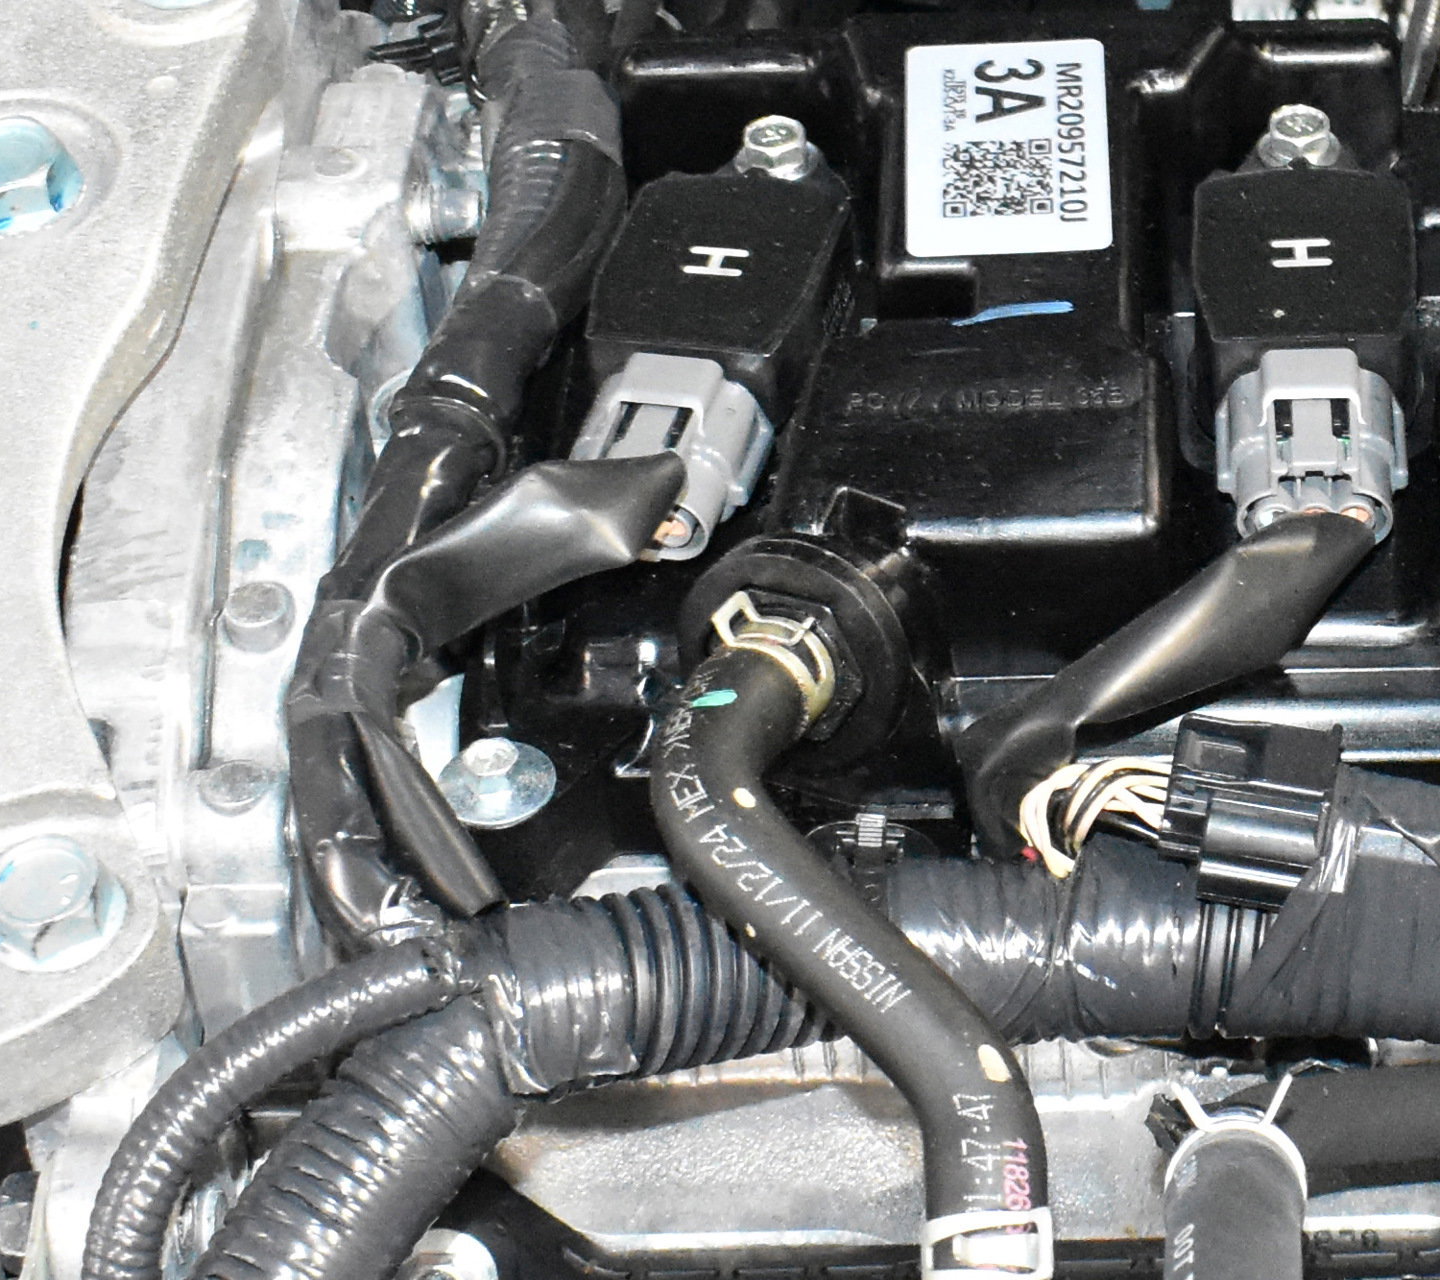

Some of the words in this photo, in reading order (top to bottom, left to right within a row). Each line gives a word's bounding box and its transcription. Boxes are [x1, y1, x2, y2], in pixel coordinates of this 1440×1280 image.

[973, 58, 1047, 123] 3A
[1055, 62, 1088, 223] MR20957210J
[681, 244, 751, 278] H
[1269, 237, 1334, 269] H
[665, 763, 715, 823] MEX
[699, 823, 824, 937] 11/12/24
[812, 926, 912, 1014] NISSAN
[952, 1093, 1002, 1214] 1:47:47
